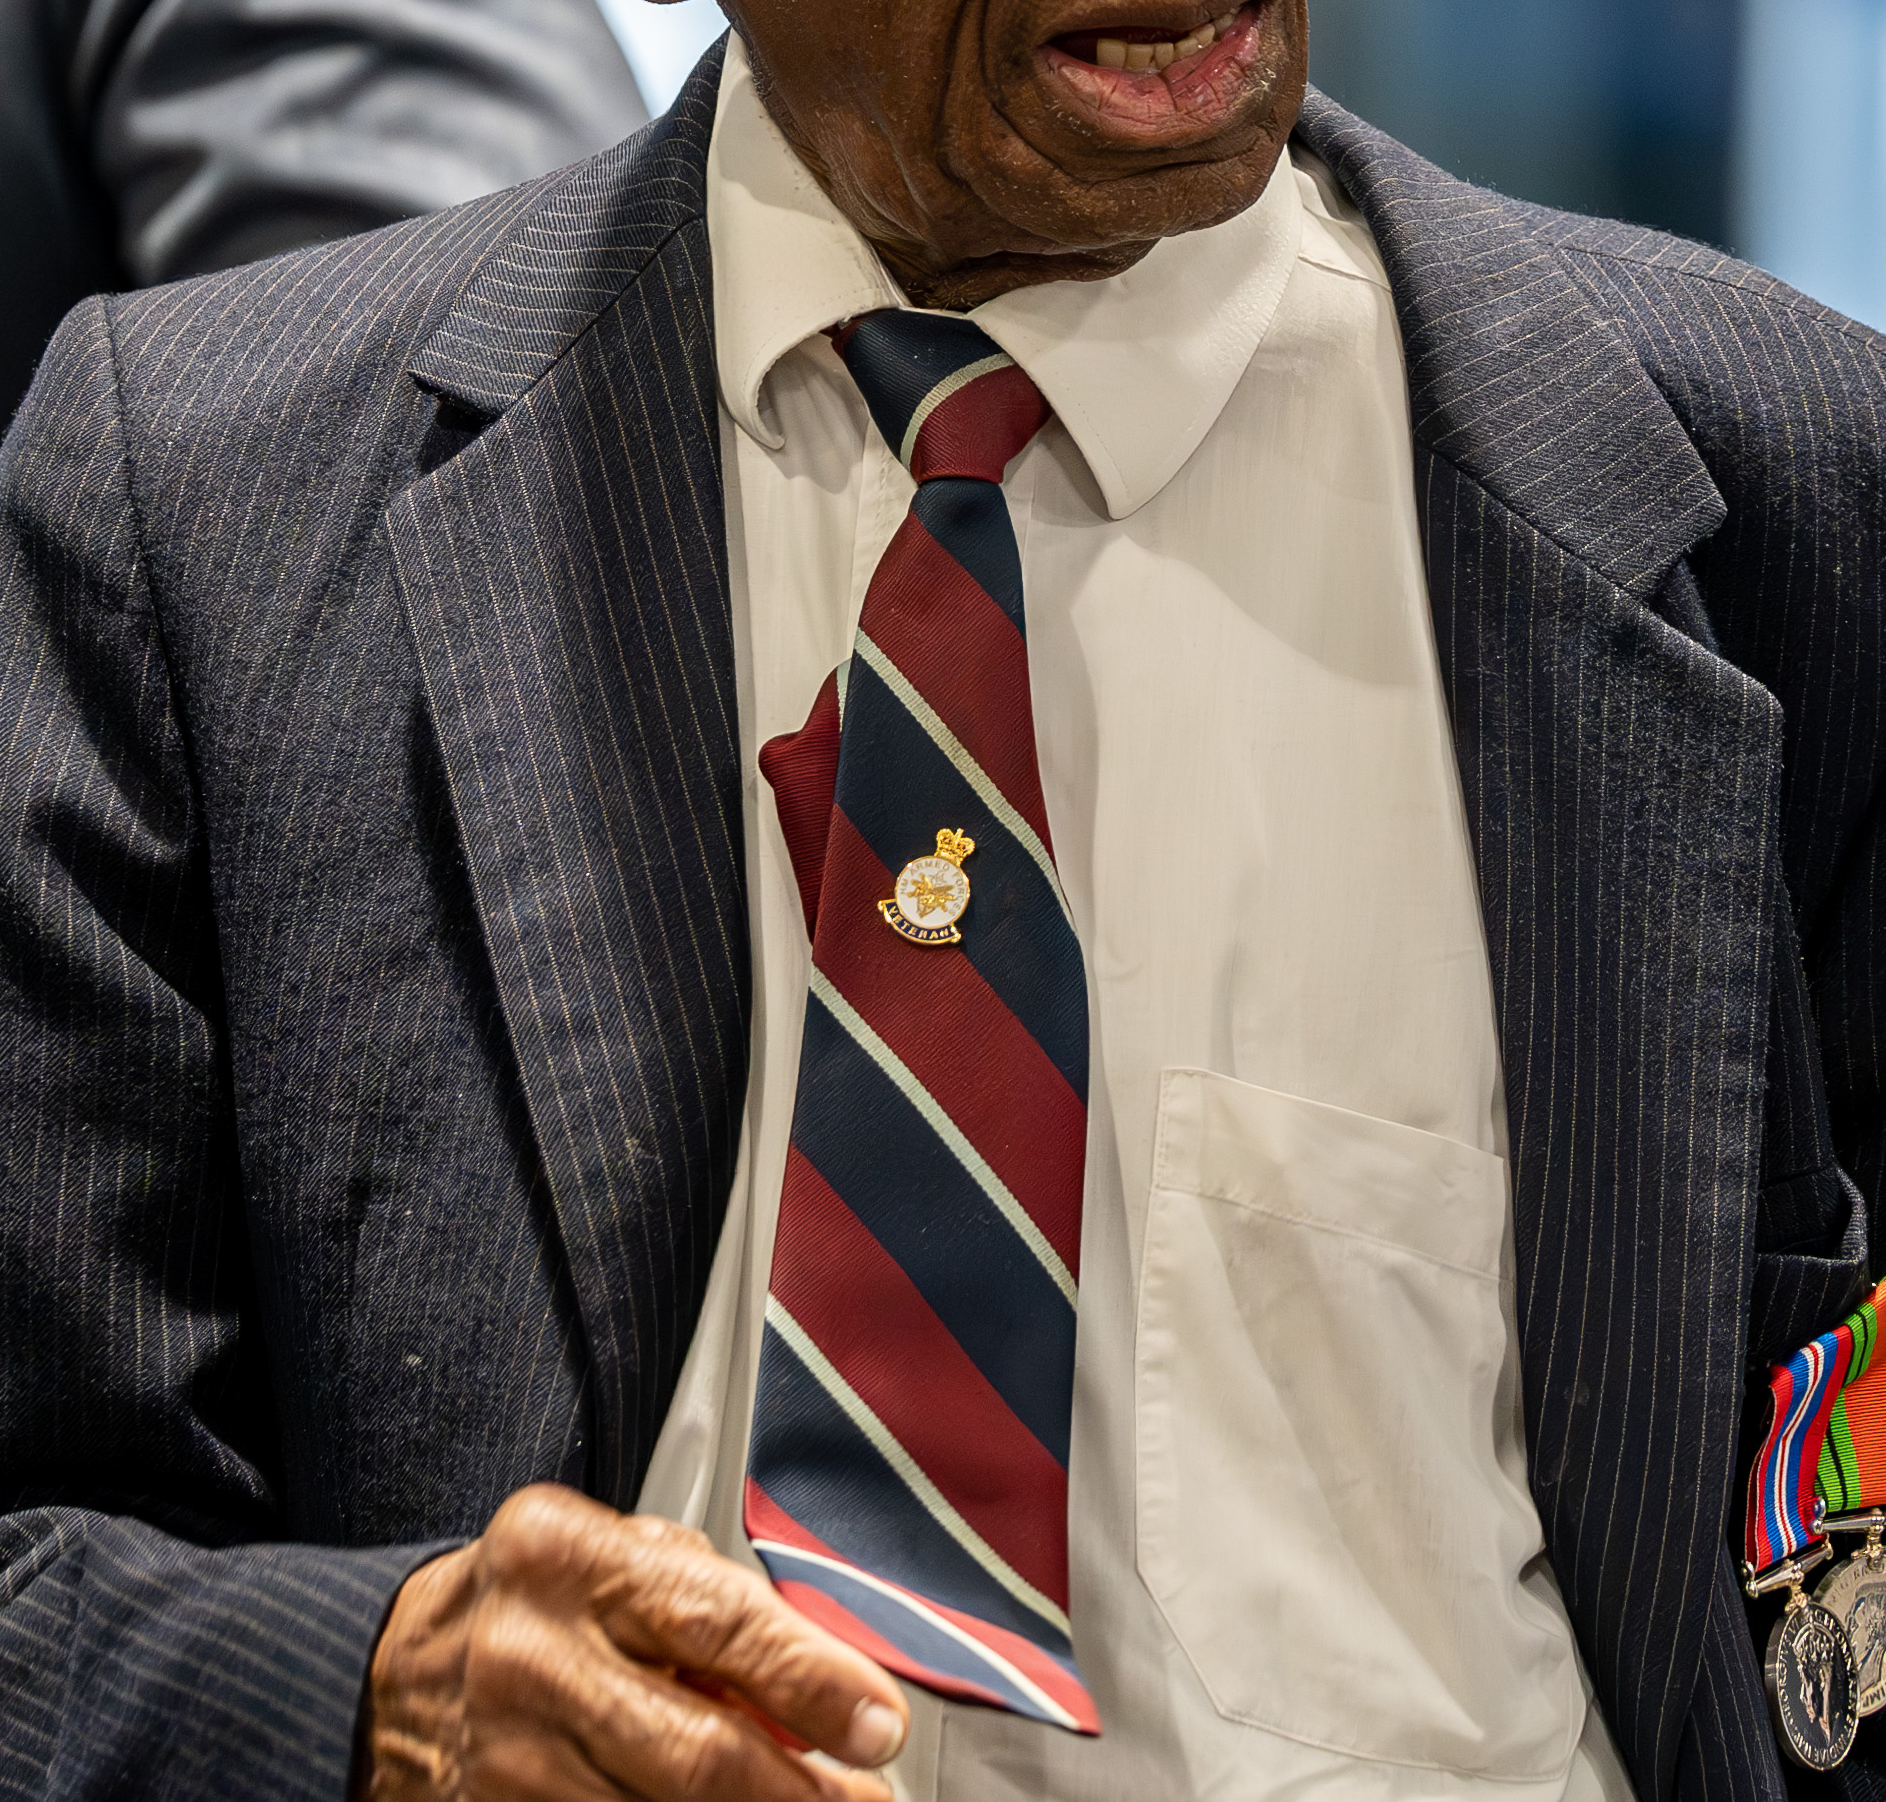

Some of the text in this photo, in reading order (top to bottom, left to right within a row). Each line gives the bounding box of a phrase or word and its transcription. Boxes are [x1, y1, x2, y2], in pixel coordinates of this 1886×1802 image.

[899, 860, 965, 917] HM ARMED FORCES
[889, 905, 949, 939] VETERAN
